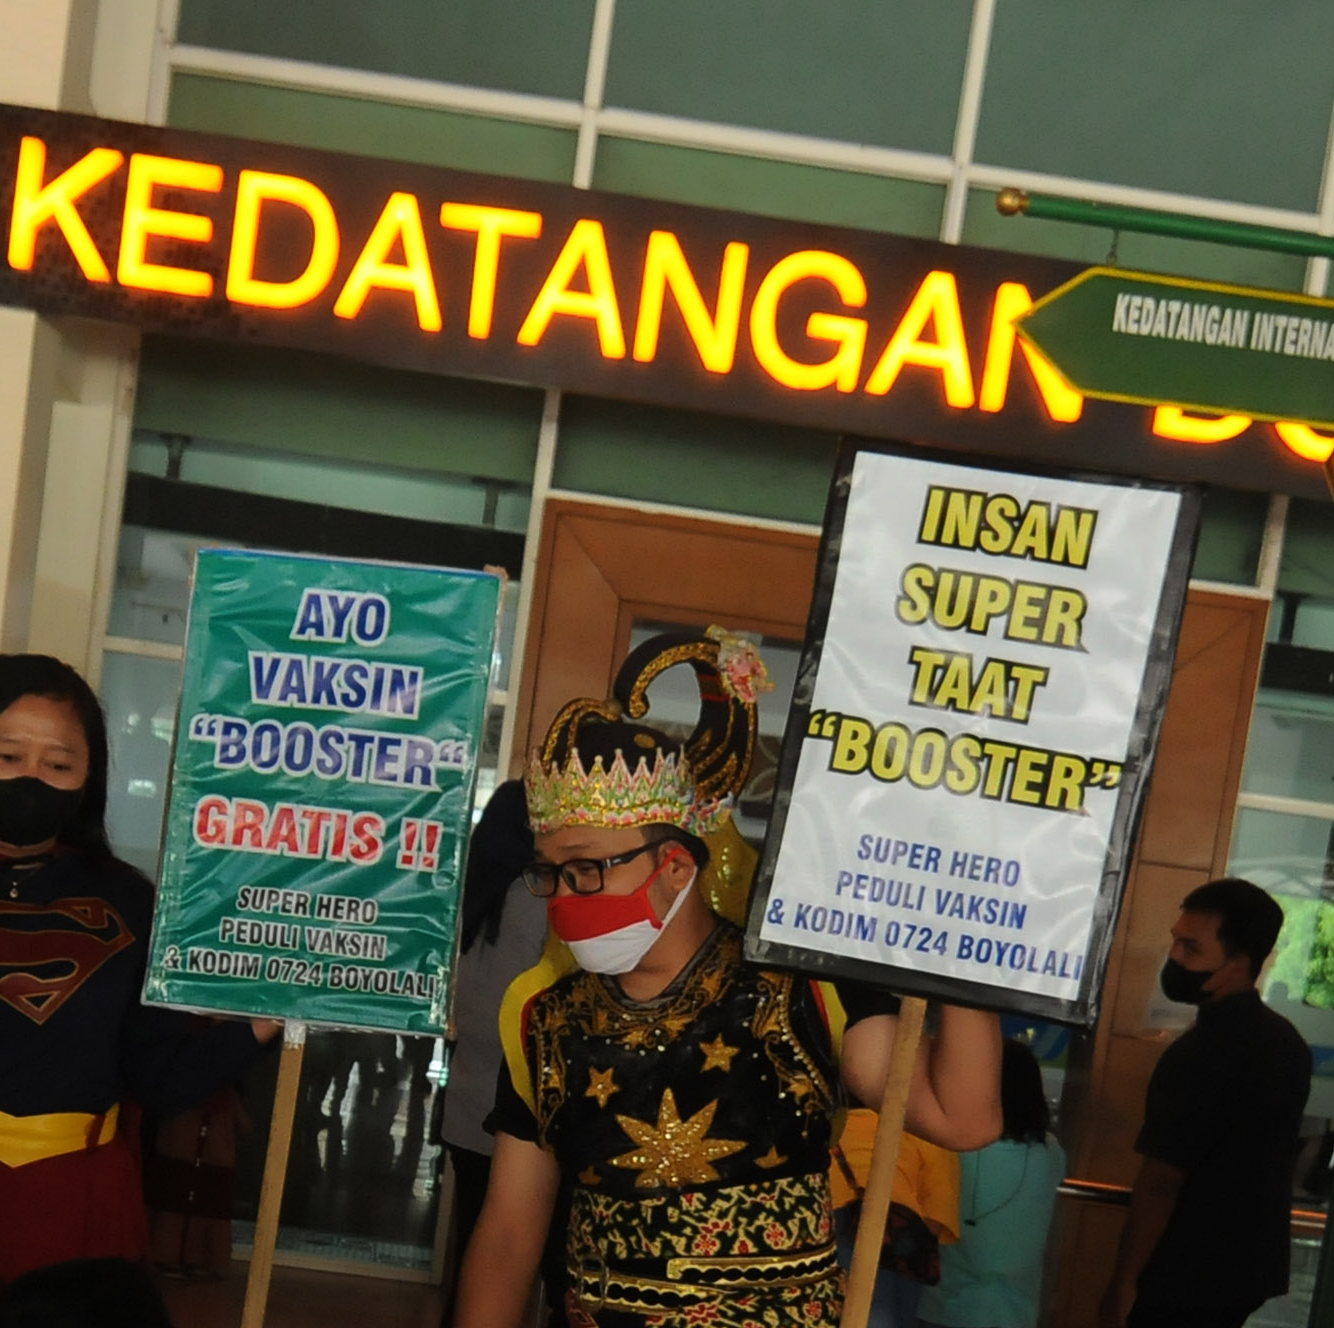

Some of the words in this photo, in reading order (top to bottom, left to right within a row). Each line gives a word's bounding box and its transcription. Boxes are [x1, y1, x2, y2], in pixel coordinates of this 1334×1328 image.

[1112, 292, 1249, 350] KEDATANGAN
[916, 485, 1099, 570] INSAN
[292, 588, 389, 646] AYO
[895, 563, 1089, 653] SUPER
[249, 651, 423, 719] VAKSIN
[908, 646, 1050, 725] TAAT
[193, 795, 385, 865] GRATIS
[397, 817, 442, 872] !!
[856, 833, 941, 875] SUPER
[949, 848, 1022, 888] HERO
[237, 885, 308, 917] SUPER
[316, 896, 377, 924] HERO
[835, 869, 924, 913] PEDULI
[934, 885, 1029, 931] VAKSIN
[219, 916, 299, 953] PEDULI
[306, 927, 387, 961] VAKSIN
[766, 899, 784, 925] &
[793, 902, 878, 944] KODIM
[884, 917, 949, 958] 0724
[956, 928, 1084, 982] BOYOLALI
[163, 948, 179, 969] &
[188, 950, 260, 979] KODIM
[265, 958, 321, 987] 0724
[329, 965, 436, 998] BOYOLALI
